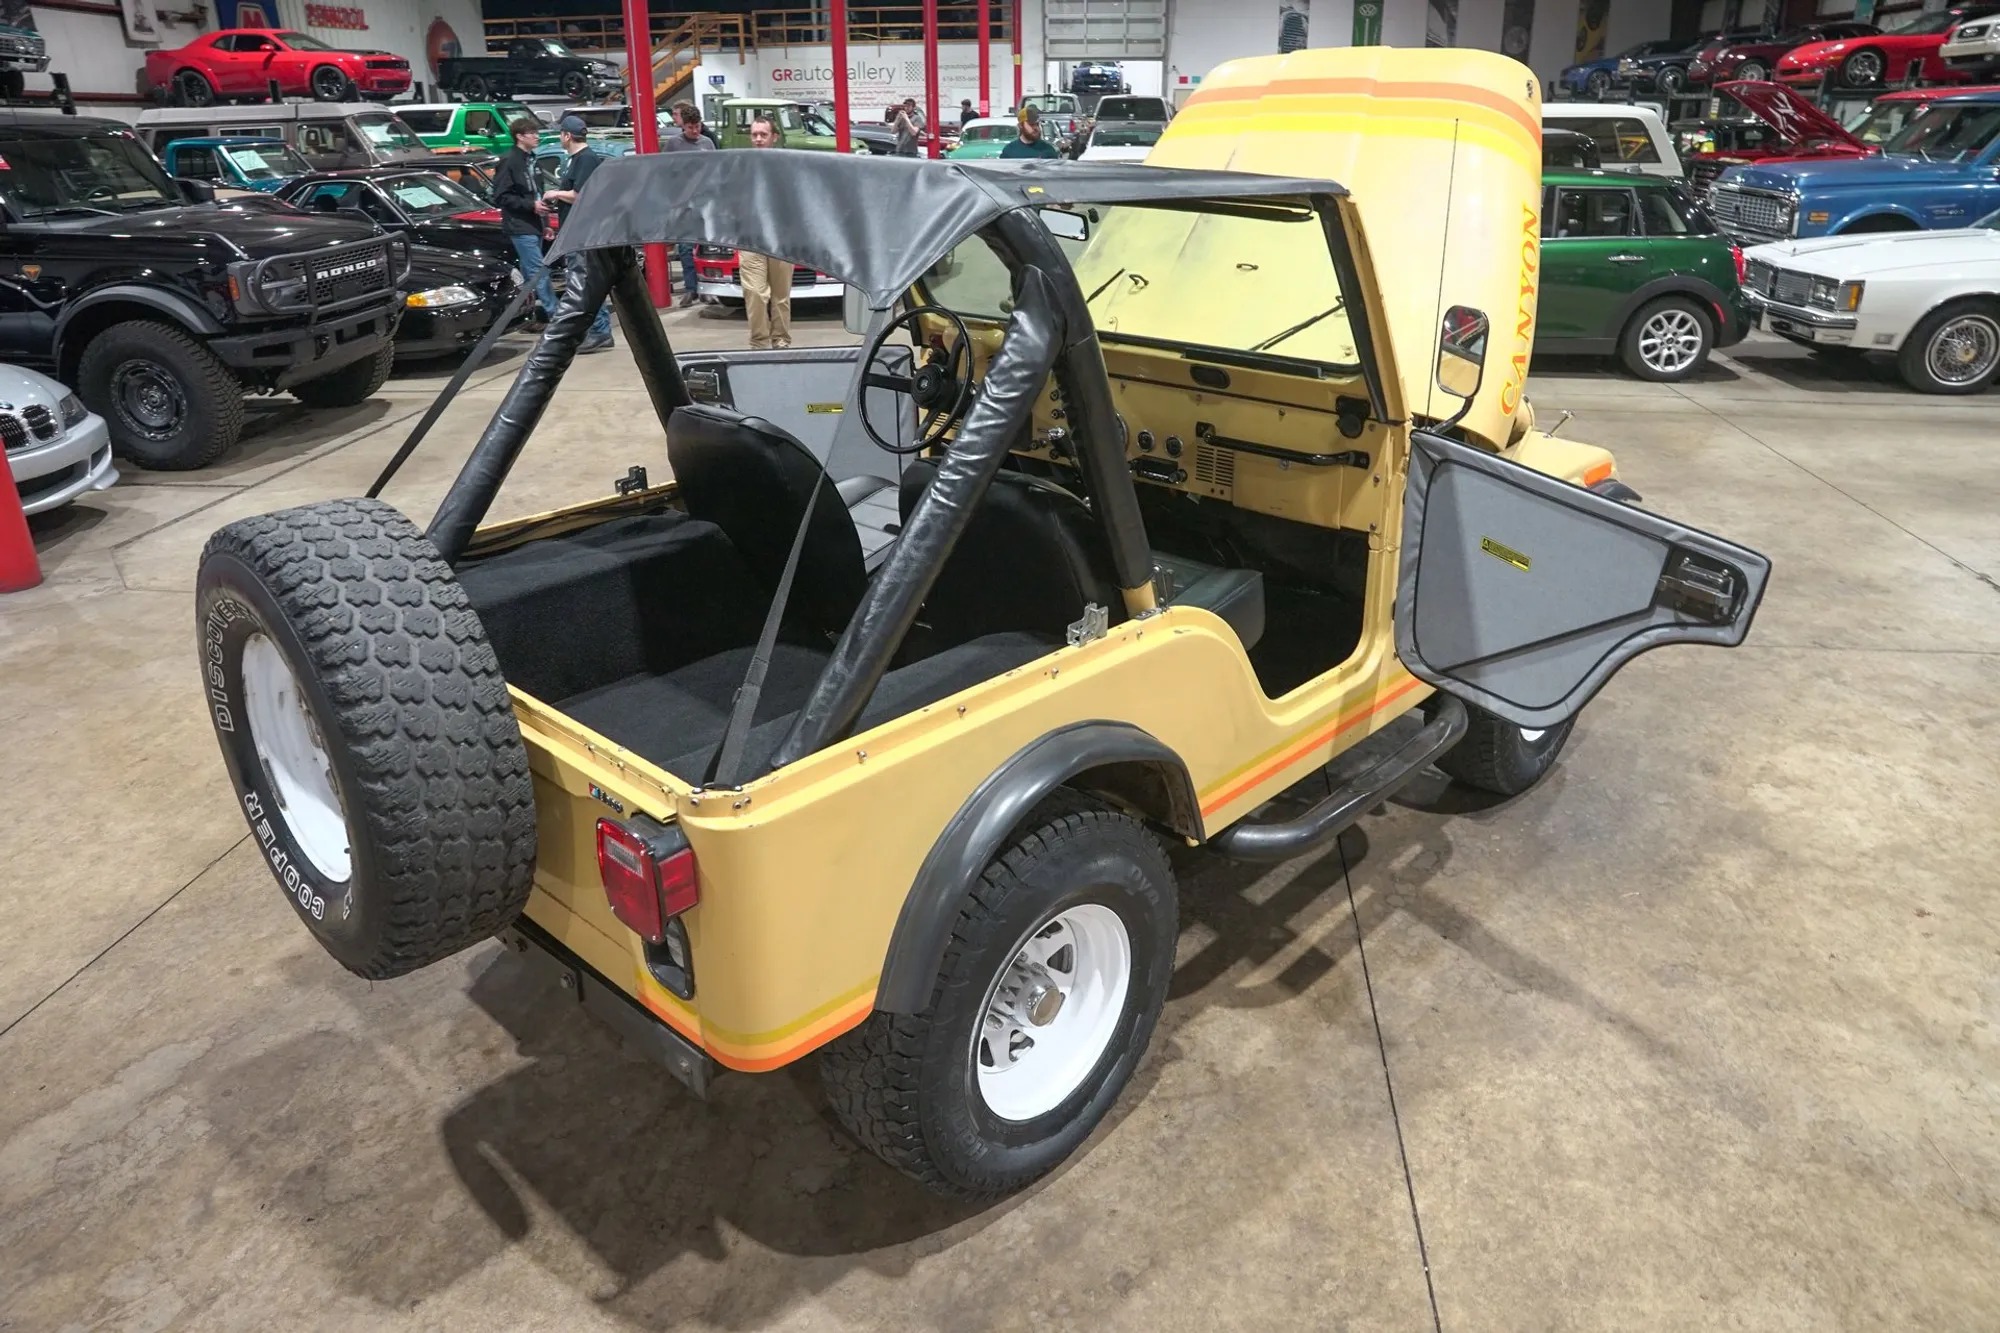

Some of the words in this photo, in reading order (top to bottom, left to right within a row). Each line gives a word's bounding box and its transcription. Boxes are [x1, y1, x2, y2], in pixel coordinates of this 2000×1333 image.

[772, 61, 896, 84] GRautoallery
[303, 260, 376, 281] RONCO
[1500, 203, 1537, 416] CANYON
[244, 791, 325, 920] COOPER
